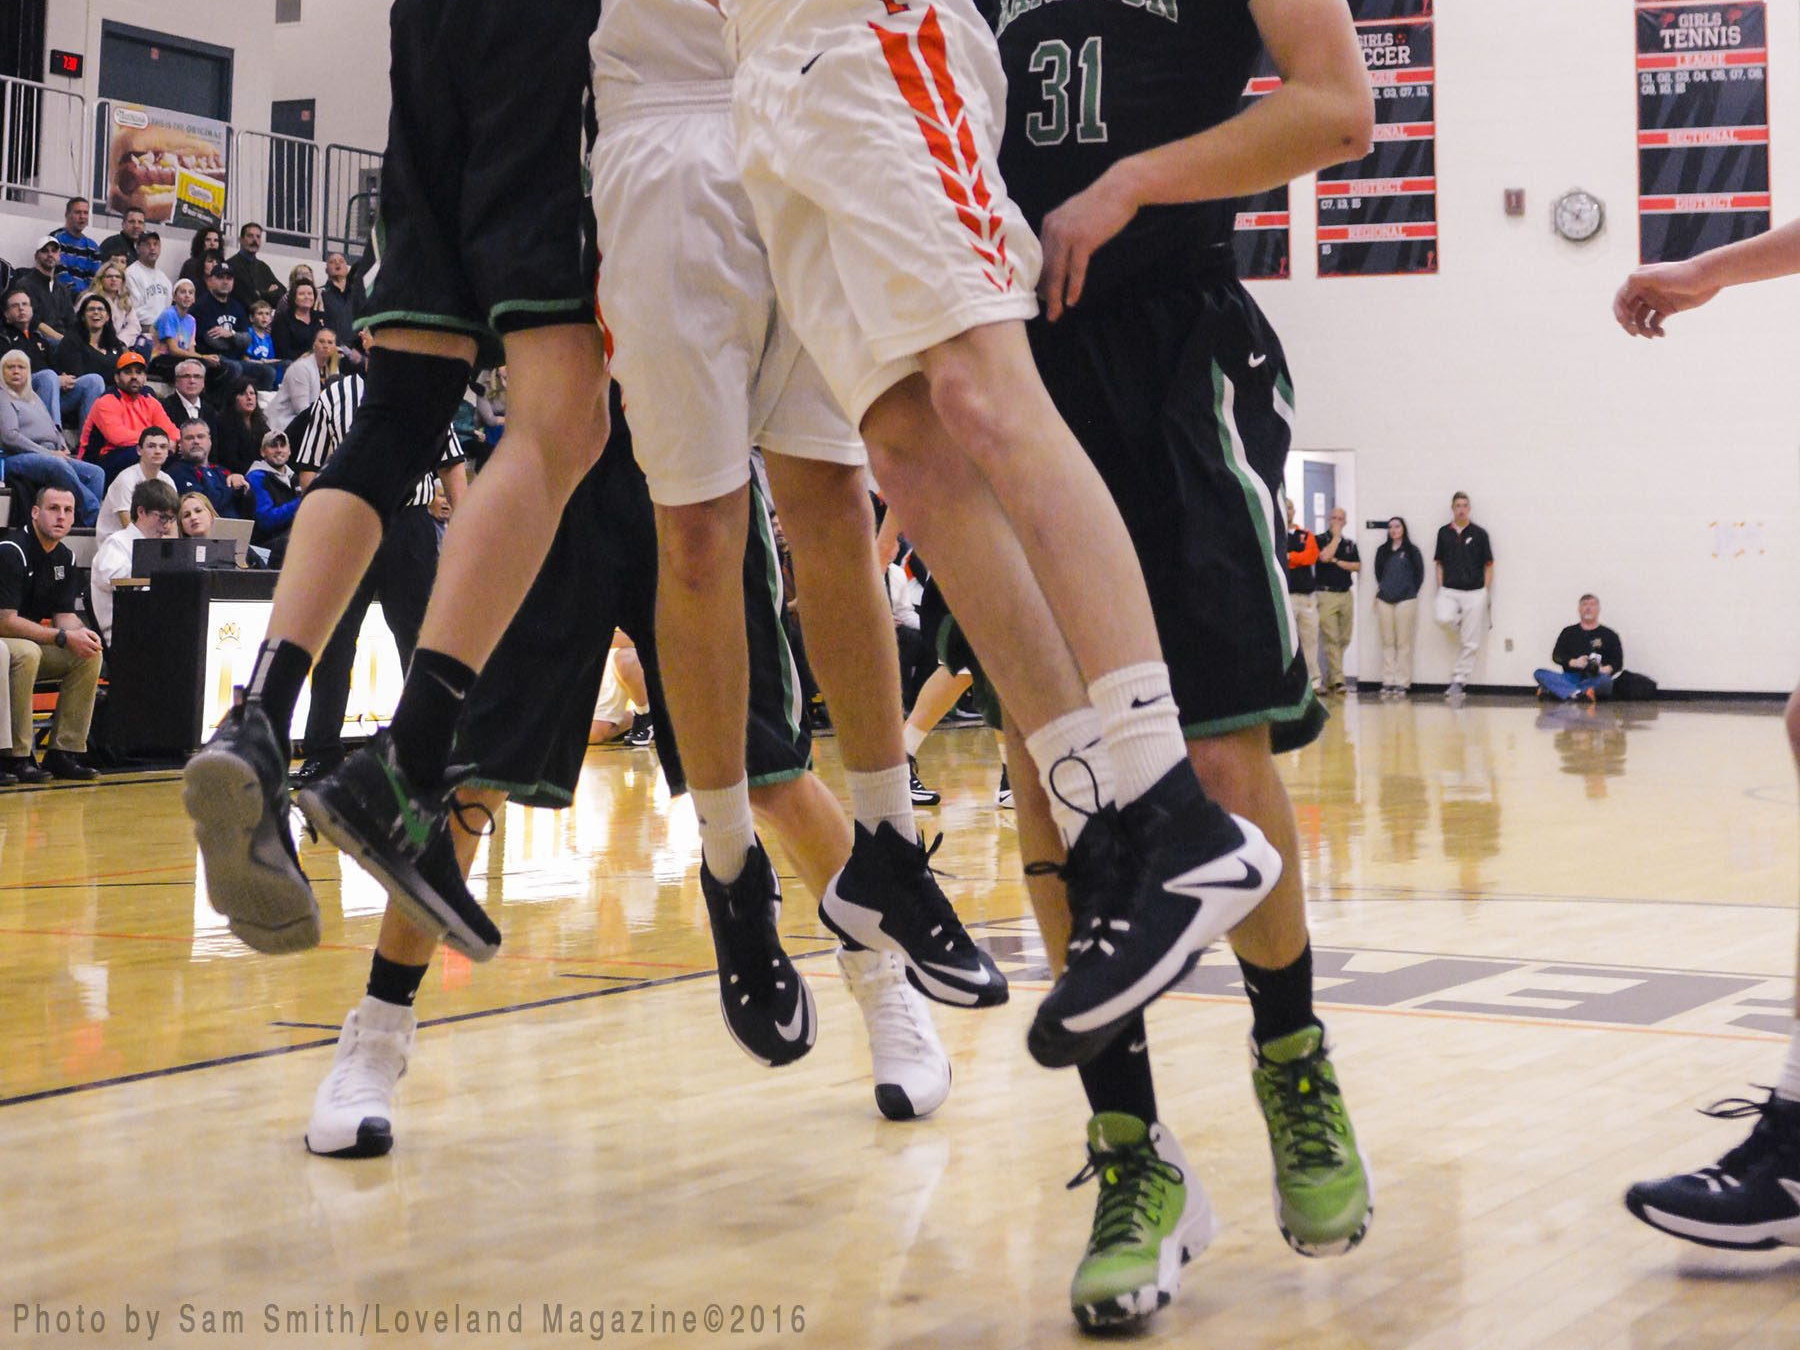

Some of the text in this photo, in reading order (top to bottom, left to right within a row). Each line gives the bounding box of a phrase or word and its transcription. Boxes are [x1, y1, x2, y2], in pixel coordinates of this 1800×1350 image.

[1678, 12, 1722, 28] GIRLS
[1660, 25, 1741, 49] TENNIS
[1362, 46, 1411, 66] CCER
[1026, 36, 1109, 147] 31
